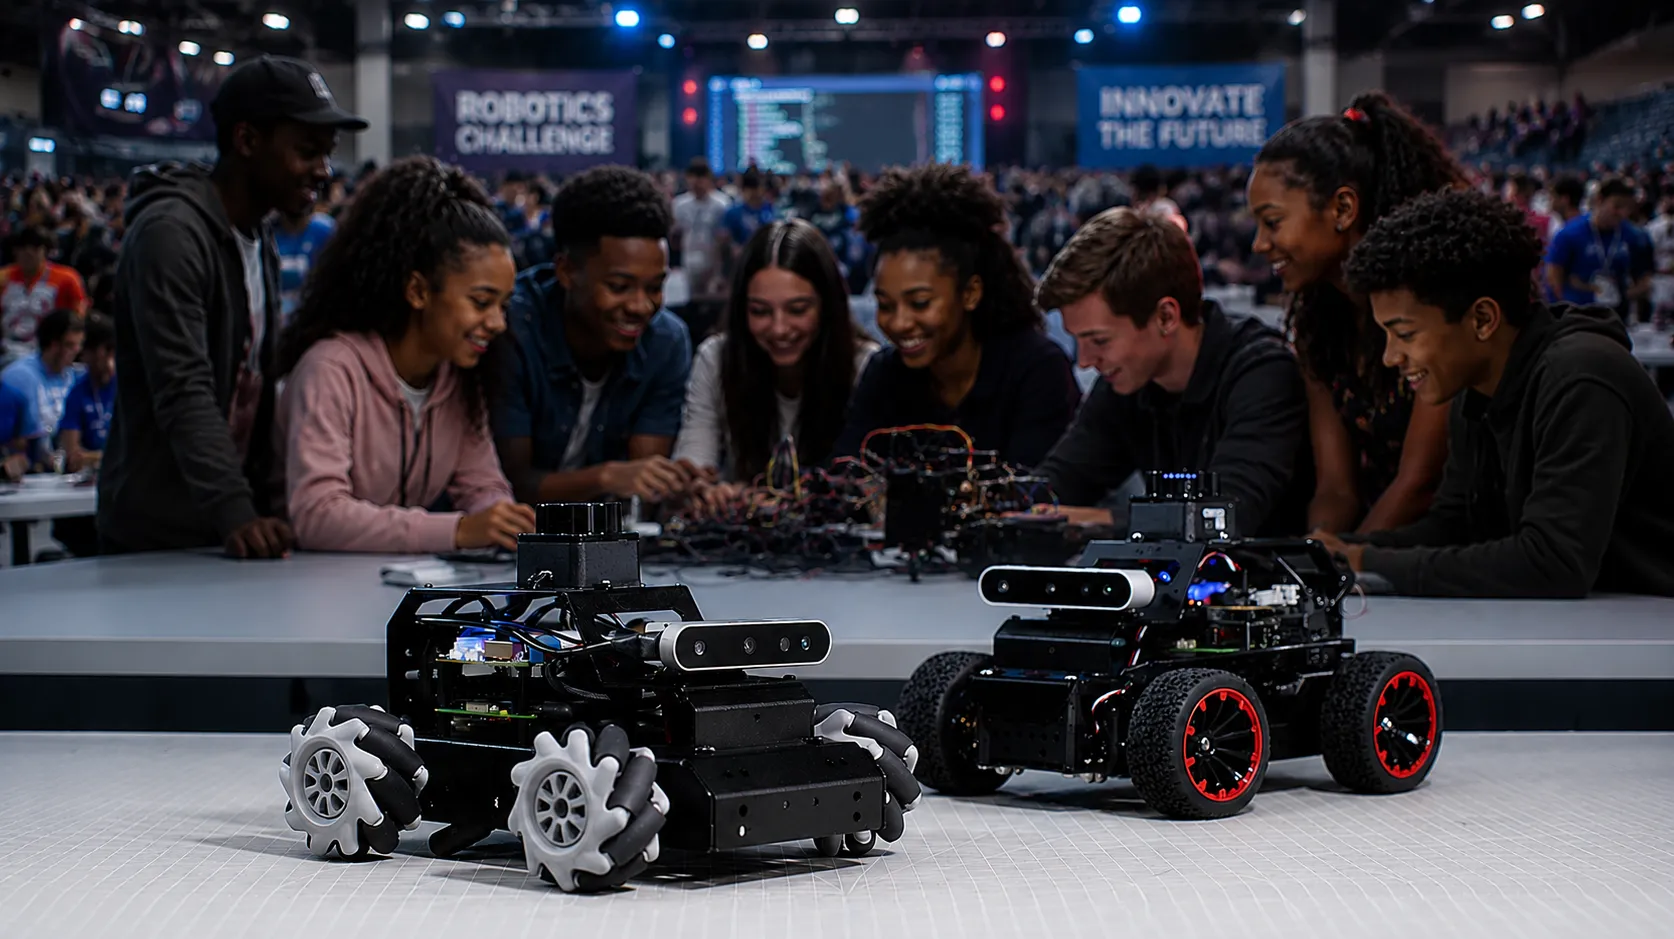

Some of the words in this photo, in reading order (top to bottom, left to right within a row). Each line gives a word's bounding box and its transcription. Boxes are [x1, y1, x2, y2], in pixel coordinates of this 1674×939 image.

[455, 90, 615, 125] ROBOTICS
[1099, 85, 1265, 118] INNOVATE
[454, 125, 615, 155] CHALLENGE
[1098, 119, 1155, 149] THE
[1157, 119, 1267, 149] FUTURE
